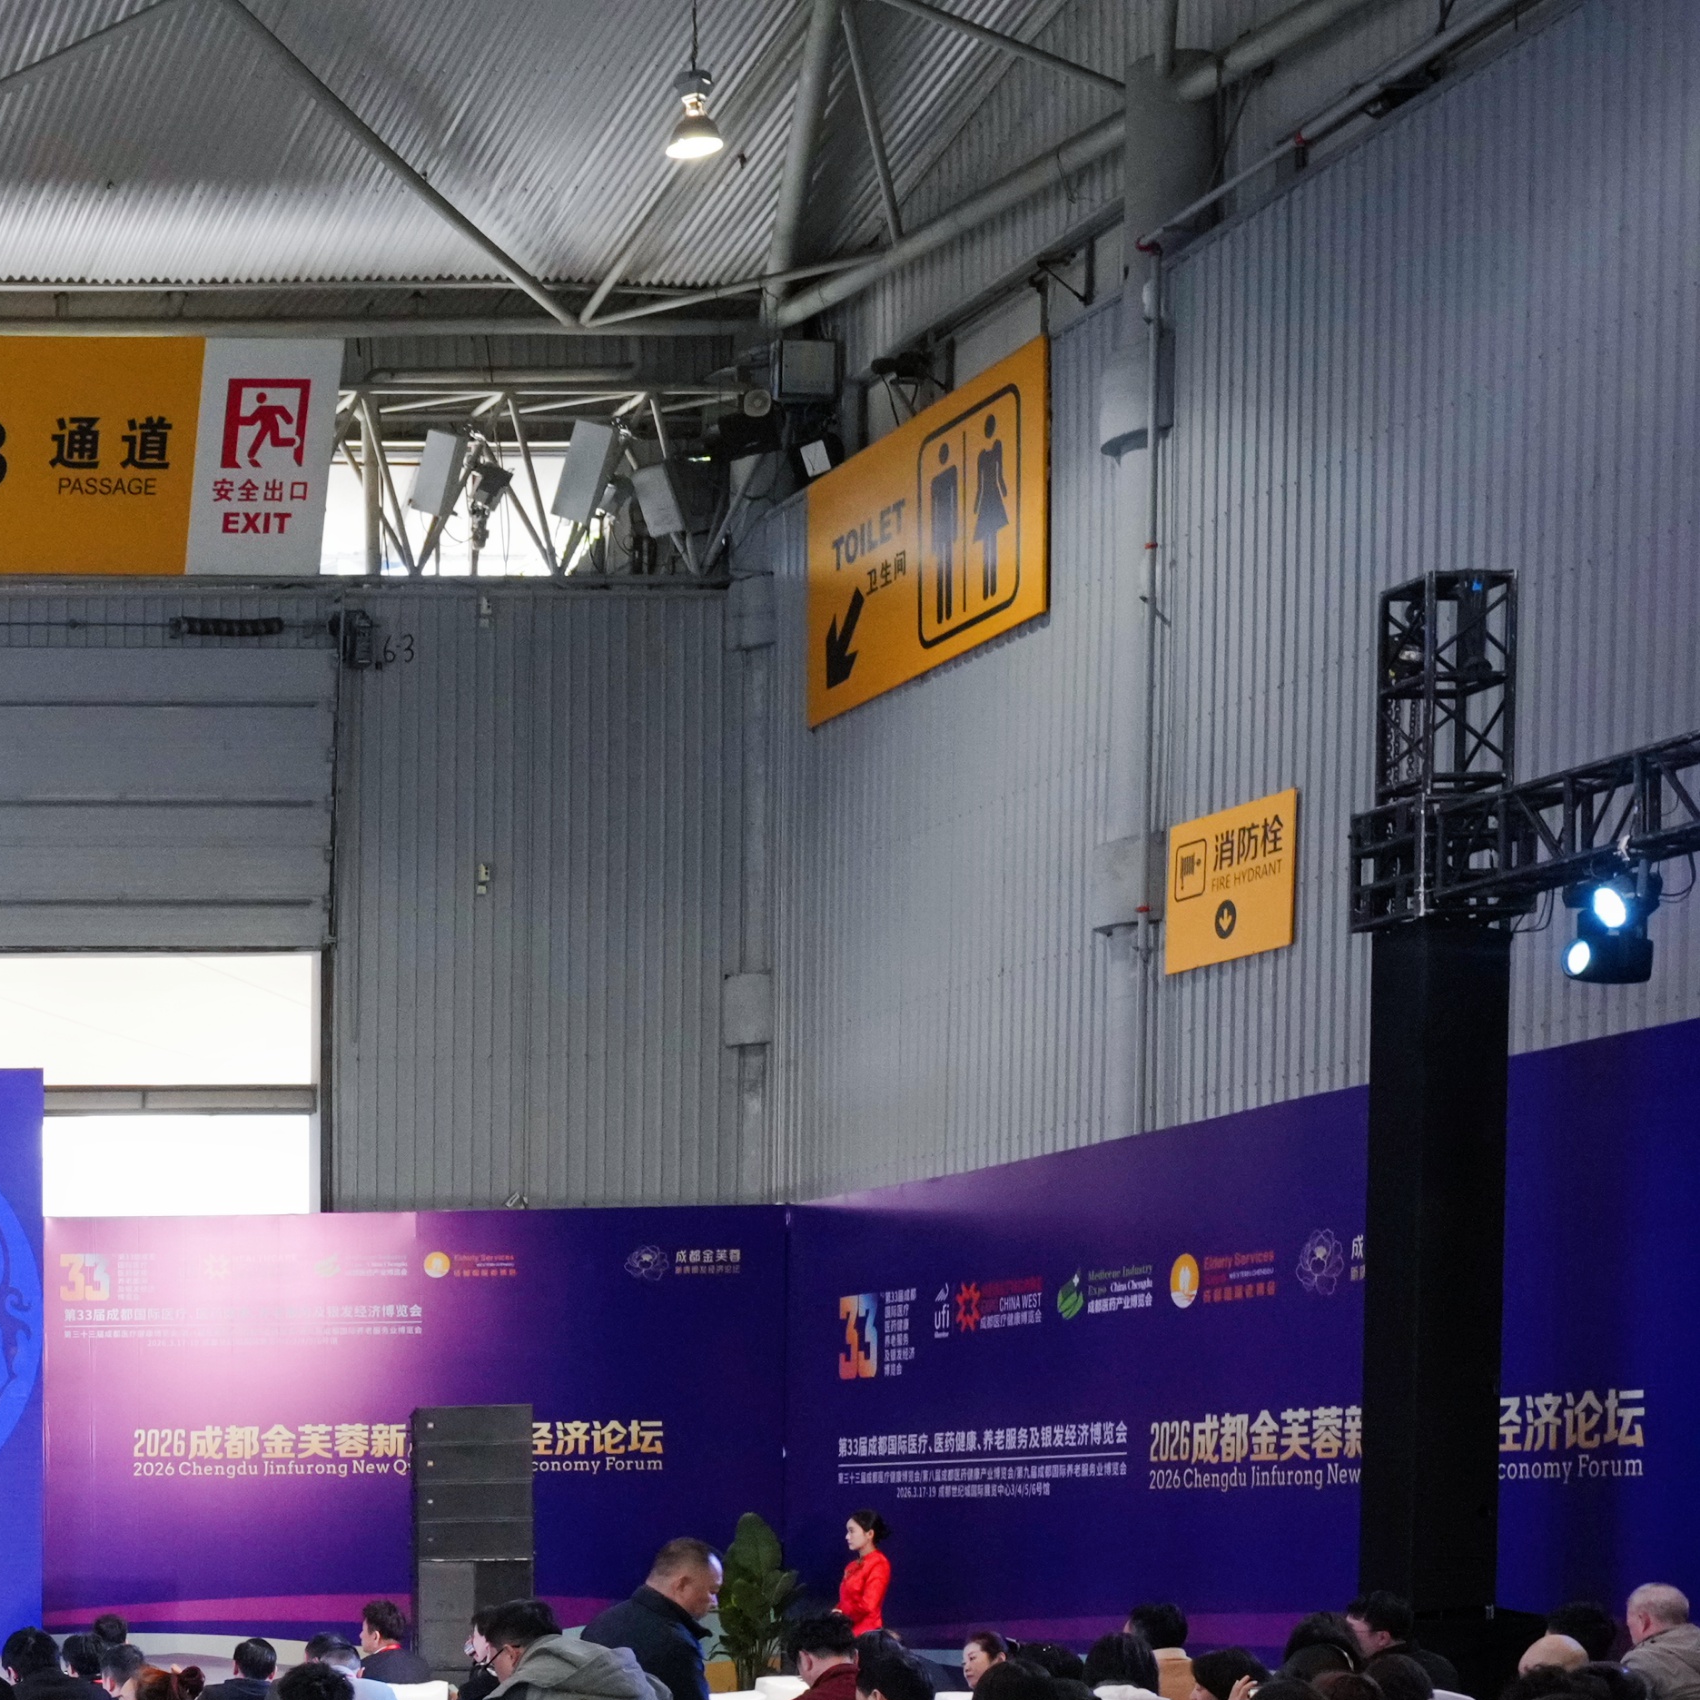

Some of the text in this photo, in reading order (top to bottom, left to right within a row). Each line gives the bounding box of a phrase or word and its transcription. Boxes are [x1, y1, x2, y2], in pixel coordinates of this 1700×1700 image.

[49, 416, 173, 470] 通道
[58, 477, 157, 496] PASSAGE
[212, 479, 308, 503] 安全出口
[221, 512, 292, 534] EXIT
[831, 498, 906, 571] TOILET
[865, 550, 907, 597] 卫生间
[1212, 814, 1284, 872] 消防栓
[1211, 859, 1283, 892] FIRE HYDRANT
[934, 1303, 950, 1330] ufi
[999, 1295, 1021, 1312] CHINA
[1022, 1292, 1043, 1309] WEST
[133, 1423, 411, 1459] 2026成都金芙蓉新
[838, 1420, 1128, 1458] 第33届成都国际医疗、医药健康、养老服务及银发经济博览会
[133, 1461, 175, 1477] 2026
[178, 1461, 258, 1478] Chengdu
[263, 1460, 348, 1477] Jinfurong
[352, 1460, 391, 1474] New
[532, 1457, 664, 1474] conomy Forum
[1149, 1463, 1361, 1492] 2026 Chengdu Jinfurong New
[1498, 1454, 1644, 1485] conomy Forum
